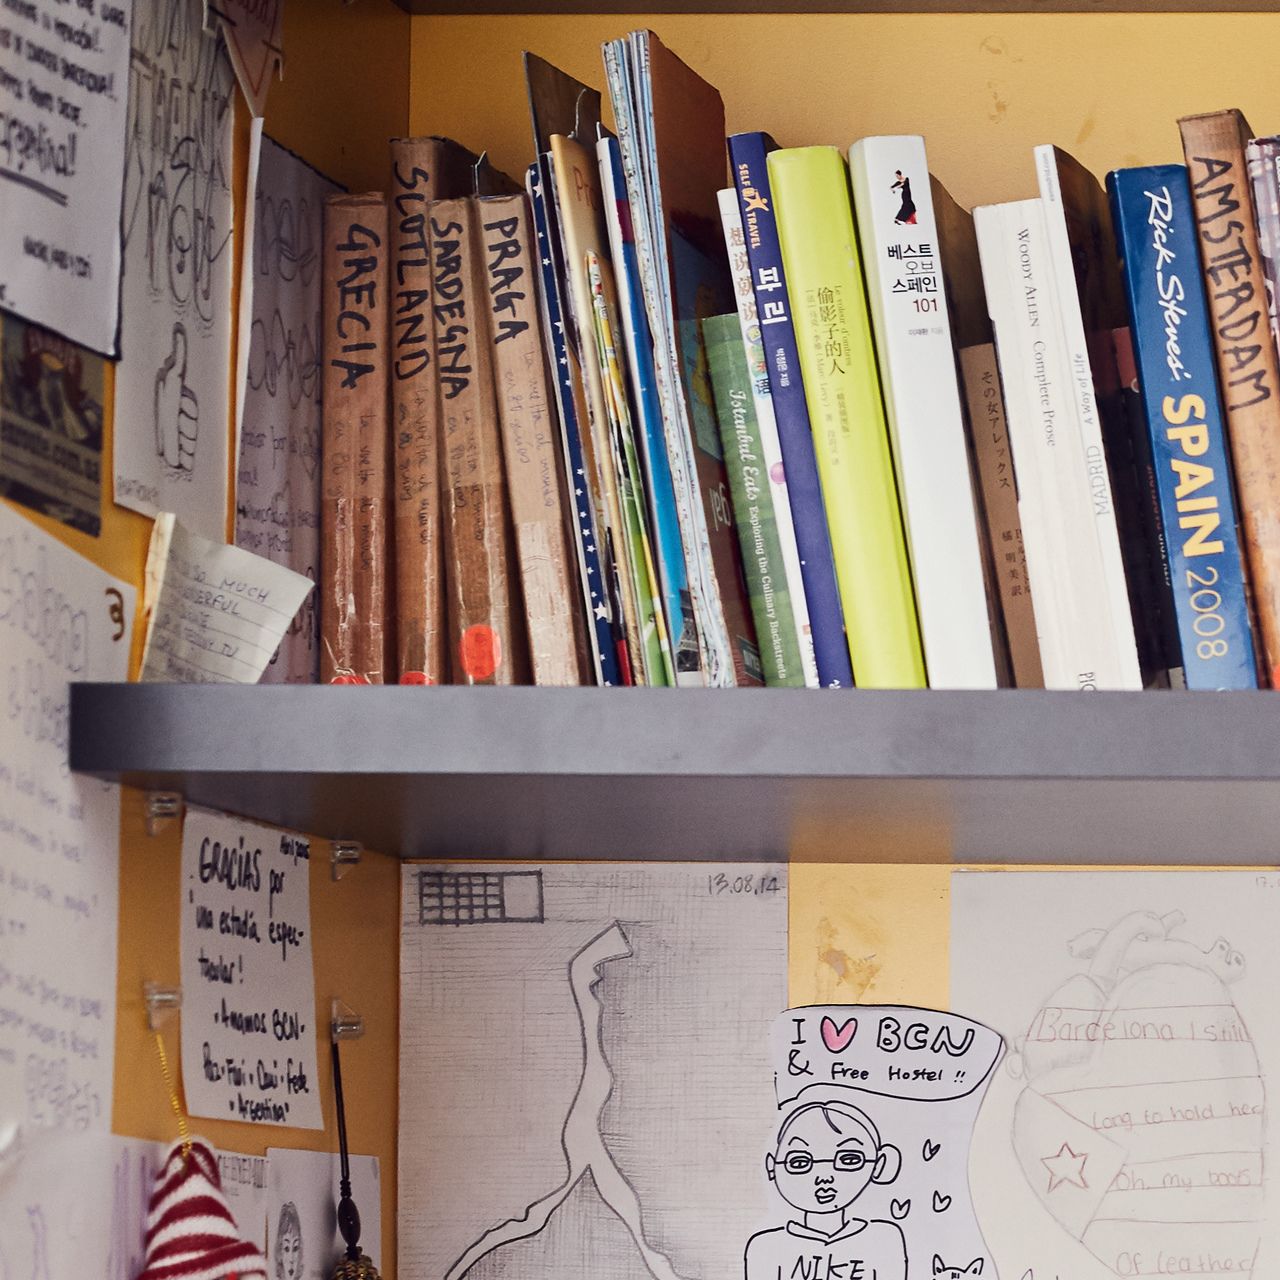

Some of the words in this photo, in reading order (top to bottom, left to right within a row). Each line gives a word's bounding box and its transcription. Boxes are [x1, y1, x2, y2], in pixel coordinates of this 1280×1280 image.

[738, 162, 750, 186] SELF
[744, 210, 761, 249] TRAVEL
[1143, 186, 1177, 271] Rick
[887, 243, 934, 260] 베스트
[905, 260, 936, 276] 오브
[331, 223, 381, 390] GRECIA
[431, 216, 473, 400] SARDEGNA
[892, 276, 938, 294] 스페인
[912, 298, 939, 314] 101
[1193, 154, 1271, 412] AMSTERDAM
[816, 286, 846, 376] 偷影子的人
[1073, 352, 1086, 376] Life
[1078, 377, 1088, 394] of
[1033, 340, 1051, 408] Complete
[1042, 409, 1056, 447] Prose
[1081, 398, 1094, 417] Way
[730, 389, 756, 461] Istanbul
[741, 460, 760, 501] Eats
[1085, 444, 1111, 516] MADRID
[1163, 394, 1224, 557] SPAIN
[749, 505, 764, 556] Exploring
[758, 557, 768, 574] the
[761, 575, 776, 619] Culinary
[1186, 566, 1228, 661] 2008
[769, 620, 787, 679] Backstreets
[792, 1018, 806, 1045] I
[876, 1016, 975, 1058] BCN
[787, 1049, 815, 1076] &
[831, 1062, 869, 1082] Free
[888, 1066, 943, 1082] Hostel
